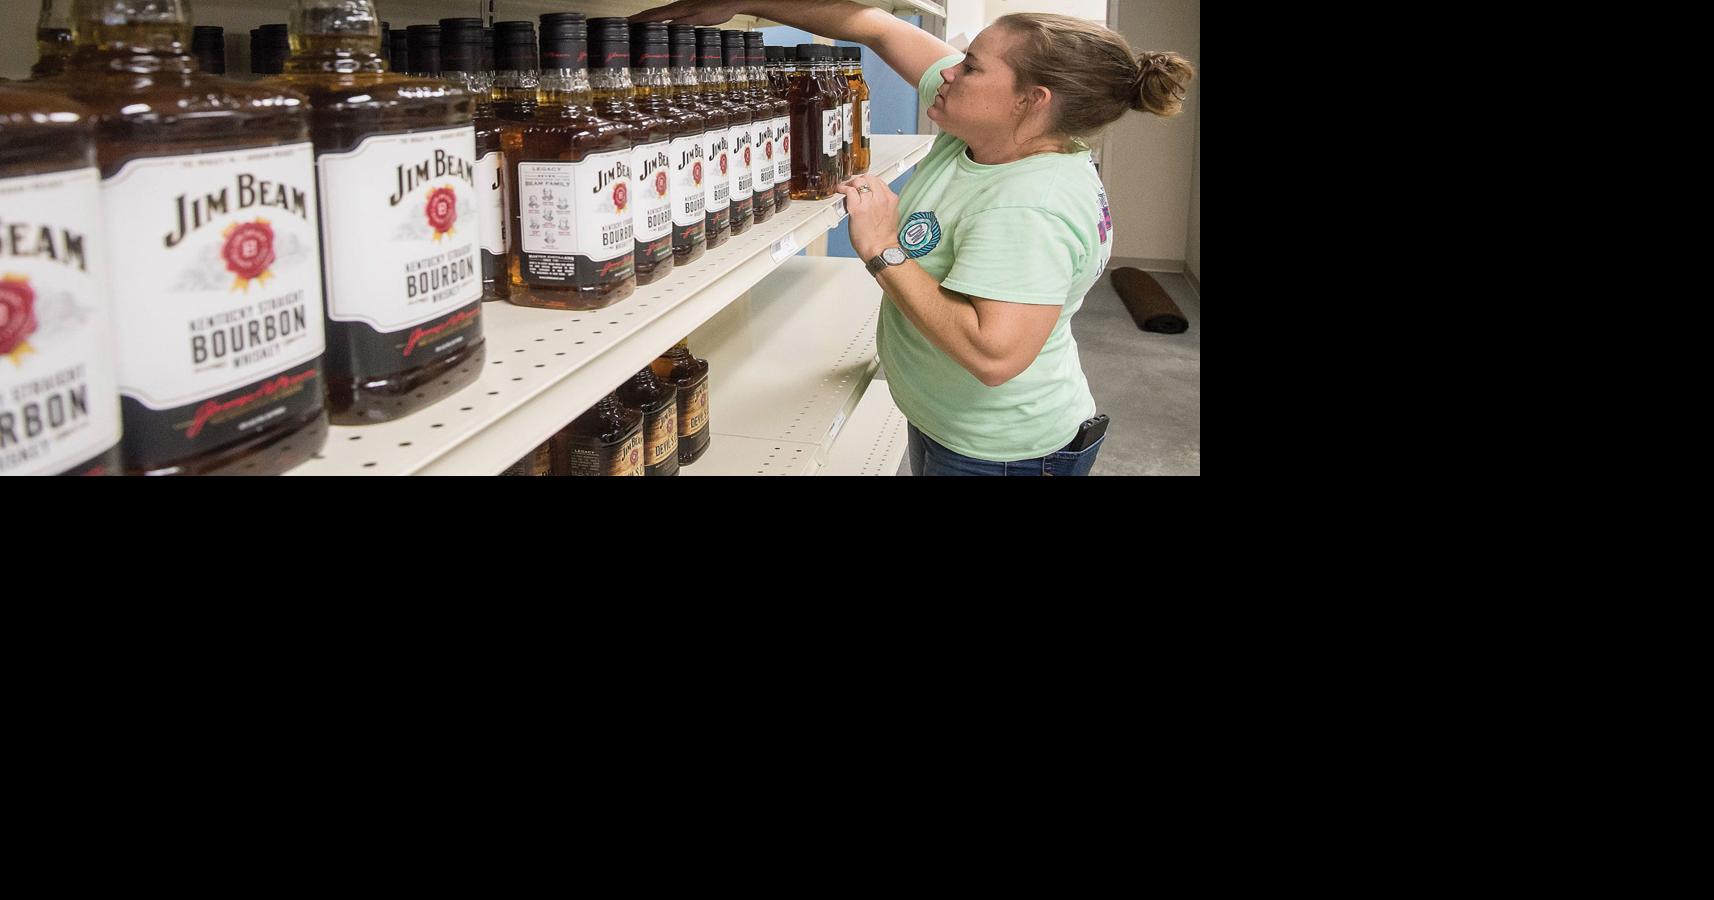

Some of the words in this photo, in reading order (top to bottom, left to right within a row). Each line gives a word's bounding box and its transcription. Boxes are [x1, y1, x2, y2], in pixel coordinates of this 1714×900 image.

[733, 134, 746, 154] JIM
[756, 131, 767, 148] JIM
[774, 126, 785, 143] JIM
[678, 149, 695, 171] JIM
[708, 139, 722, 161] JIM
[390, 159, 430, 207] JIM
[434, 149, 475, 189] BEAM
[593, 168, 616, 194] JIM
[616, 161, 632, 179] BEA
[639, 158, 657, 181] JIM
[658, 151, 670, 168] BEA
[165, 186, 229, 249] JIM
[236, 172, 308, 221] BEAM
[0, 217, 87, 272] EAM
[405, 253, 446, 273] KENTUCKY
[406, 255, 475, 299] BOURBON
[432, 286, 461, 304] WHISKEY
[189, 305, 253, 333] KENTUCKY
[191, 303, 307, 365] BOURBON
[232, 343, 281, 369] WHISKEY
